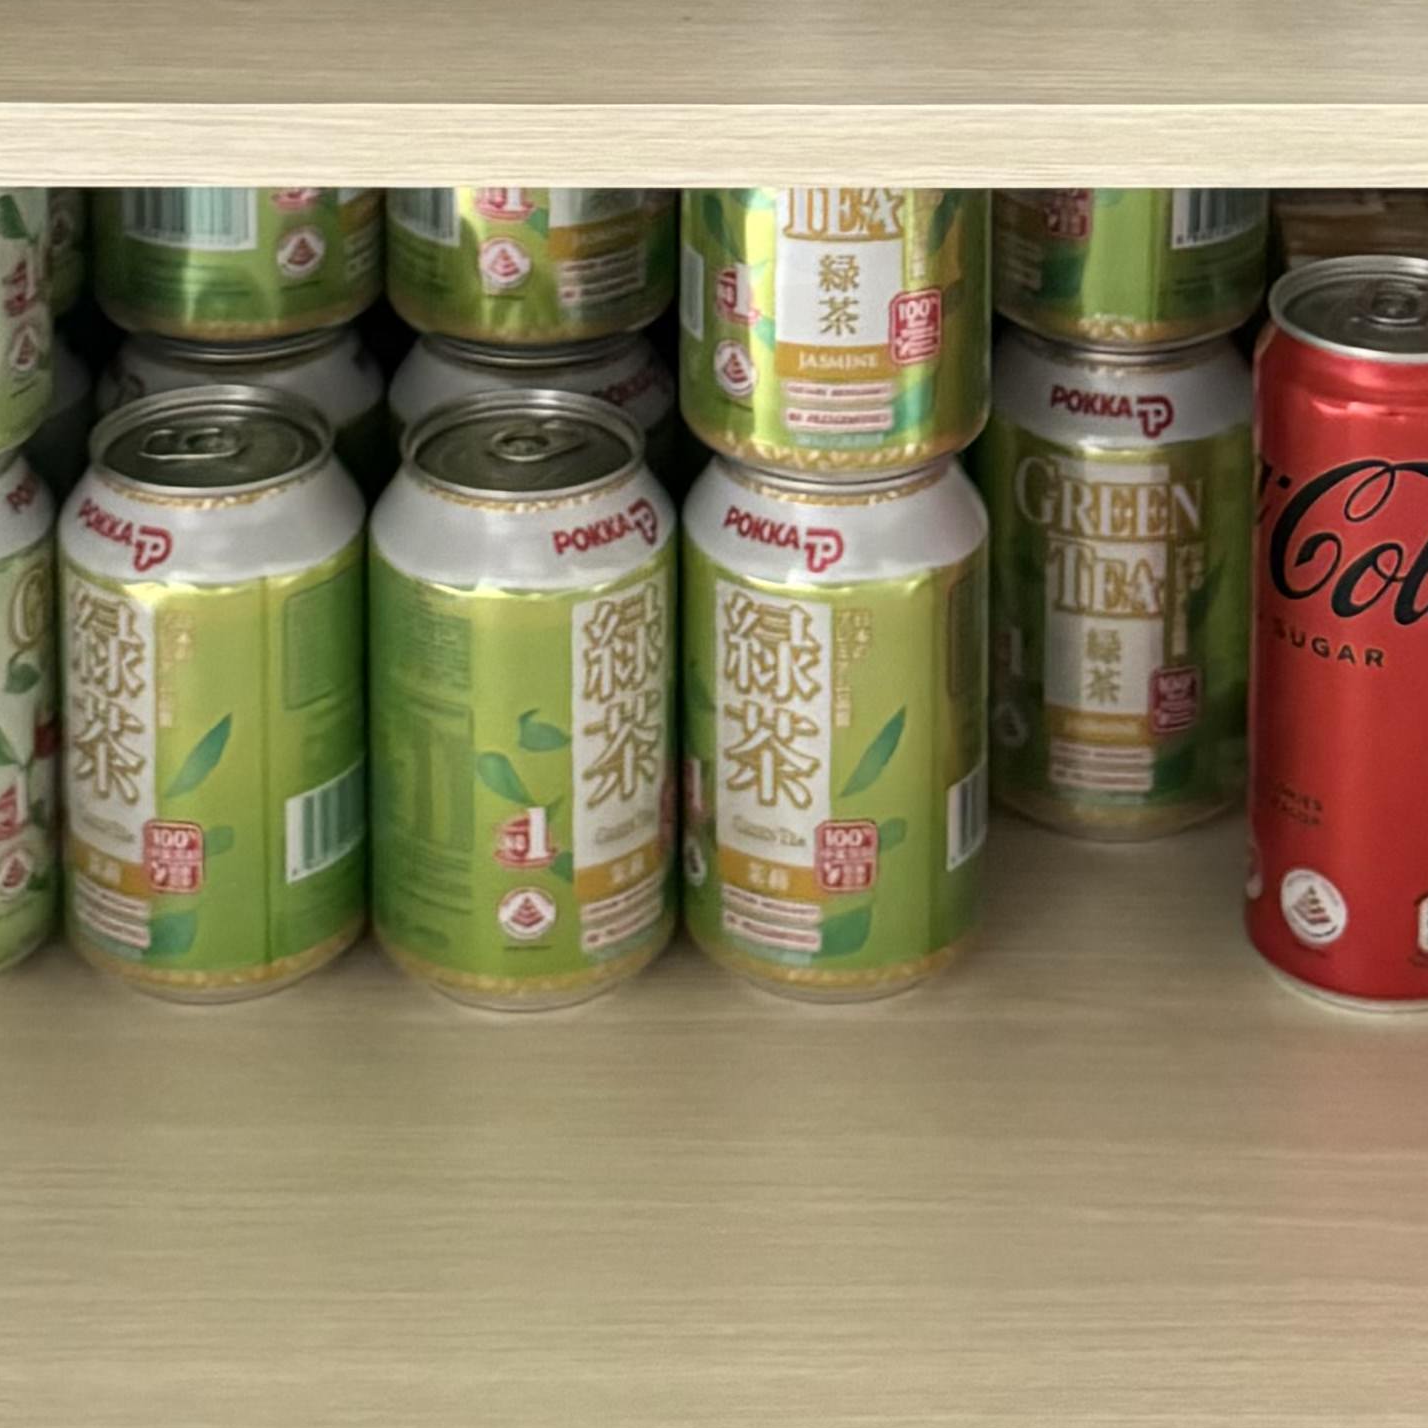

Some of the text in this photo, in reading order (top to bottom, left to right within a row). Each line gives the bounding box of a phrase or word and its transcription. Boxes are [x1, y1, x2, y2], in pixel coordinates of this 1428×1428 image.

[798, 351, 879, 371] JASMINE
[1050, 384, 1133, 419] POKKA
[1015, 456, 1203, 537] GREEN
[77, 498, 134, 545] POKKA
[553, 512, 632, 554] POKKA
[723, 505, 801, 551] POKKA
[1046, 537, 1164, 618] TEA
